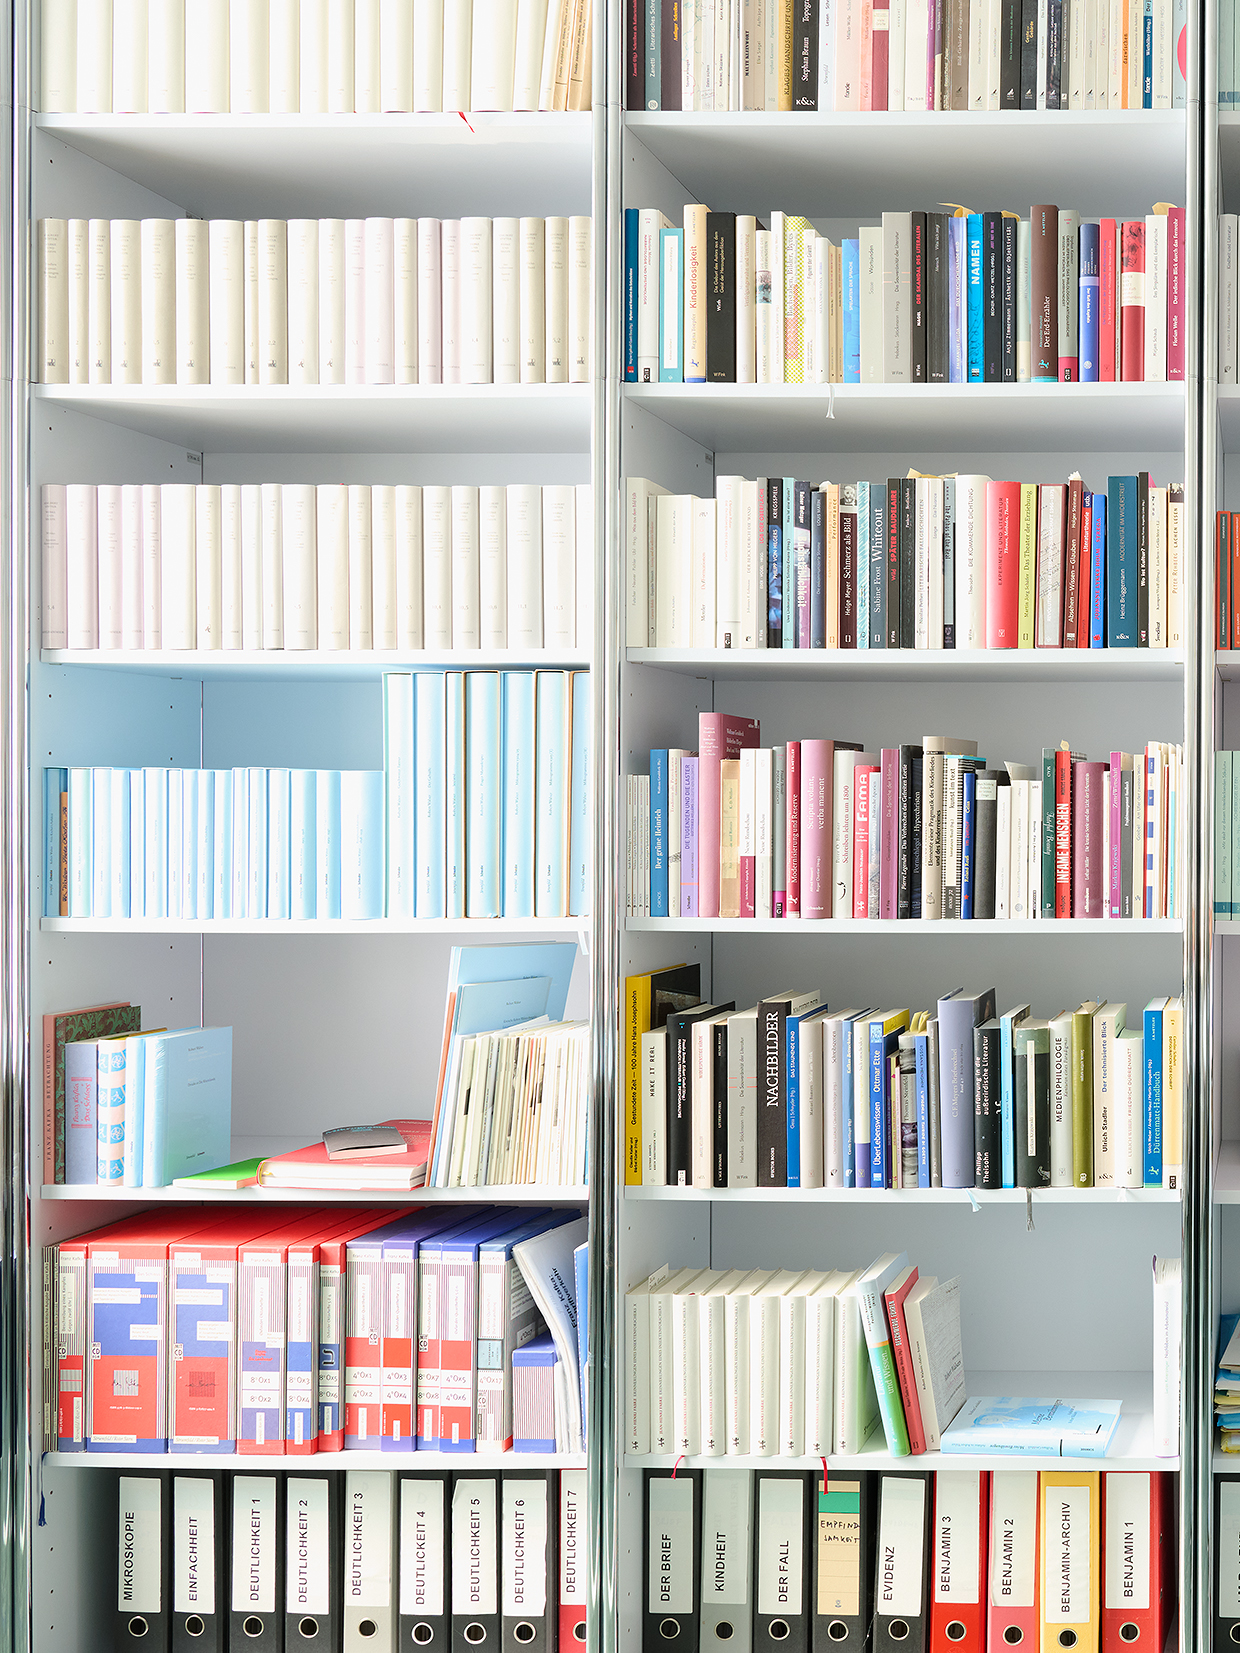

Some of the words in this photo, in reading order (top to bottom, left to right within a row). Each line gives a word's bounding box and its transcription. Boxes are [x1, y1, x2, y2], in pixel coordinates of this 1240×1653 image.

[690, 246, 699, 308] Kinderlosigkeit
[971, 241, 980, 284] NAMEN
[872, 508, 883, 562] Whiteout
[889, 490, 898, 534] BAUDELAIRE
[889, 536, 898, 562] SPÄTER
[654, 808, 662, 836] Heinrich
[654, 839, 662, 856] grüne
[1057, 803, 1069, 850] MENSCHEN
[654, 858, 662, 869] Der
[1057, 852, 1069, 883] INFAME
[766, 1011, 779, 1106] NACHBILDER
[872, 1050, 881, 1064] Ette
[872, 1065, 881, 1092] Ottmar
[872, 1101, 882, 1166] ÜberLebenswissen
[1152, 1071, 1161, 1154] Dürrenmatt-Handbuch
[124, 1512, 134, 1600] MIKROSKOPIE
[189, 1517, 197, 1600] EINFACHHEIT
[250, 1509, 260, 1600] DEUTLICHKEIT
[299, 1511, 307, 1602] DEUTLICHKEIT
[352, 1504, 362, 1595] DEUTLICHKEIT
[416, 1522, 425, 1604] DEUTLICKEIT
[471, 1510, 480, 1601] DEUTLICHKEIT
[515, 1511, 524, 1603] DEUTLICHKEIT
[566, 1501, 576, 1592] DEUTLICHKEIT
[662, 1534, 670, 1570] BRIEF
[715, 1532, 725, 1591] KINDHEIT
[779, 1541, 788, 1571] FALL
[884, 1547, 894, 1600] EVIDENZ
[941, 1528, 950, 1591] BENJAMIN
[1002, 1531, 1013, 1594] BENJAMIN
[1062, 1503, 1070, 1612] BENJAMIN-ARCHIV
[1124, 1533, 1133, 1597] BENJAMIN
[661, 1576, 670, 1601] DER
[779, 1577, 788, 1602] DER
